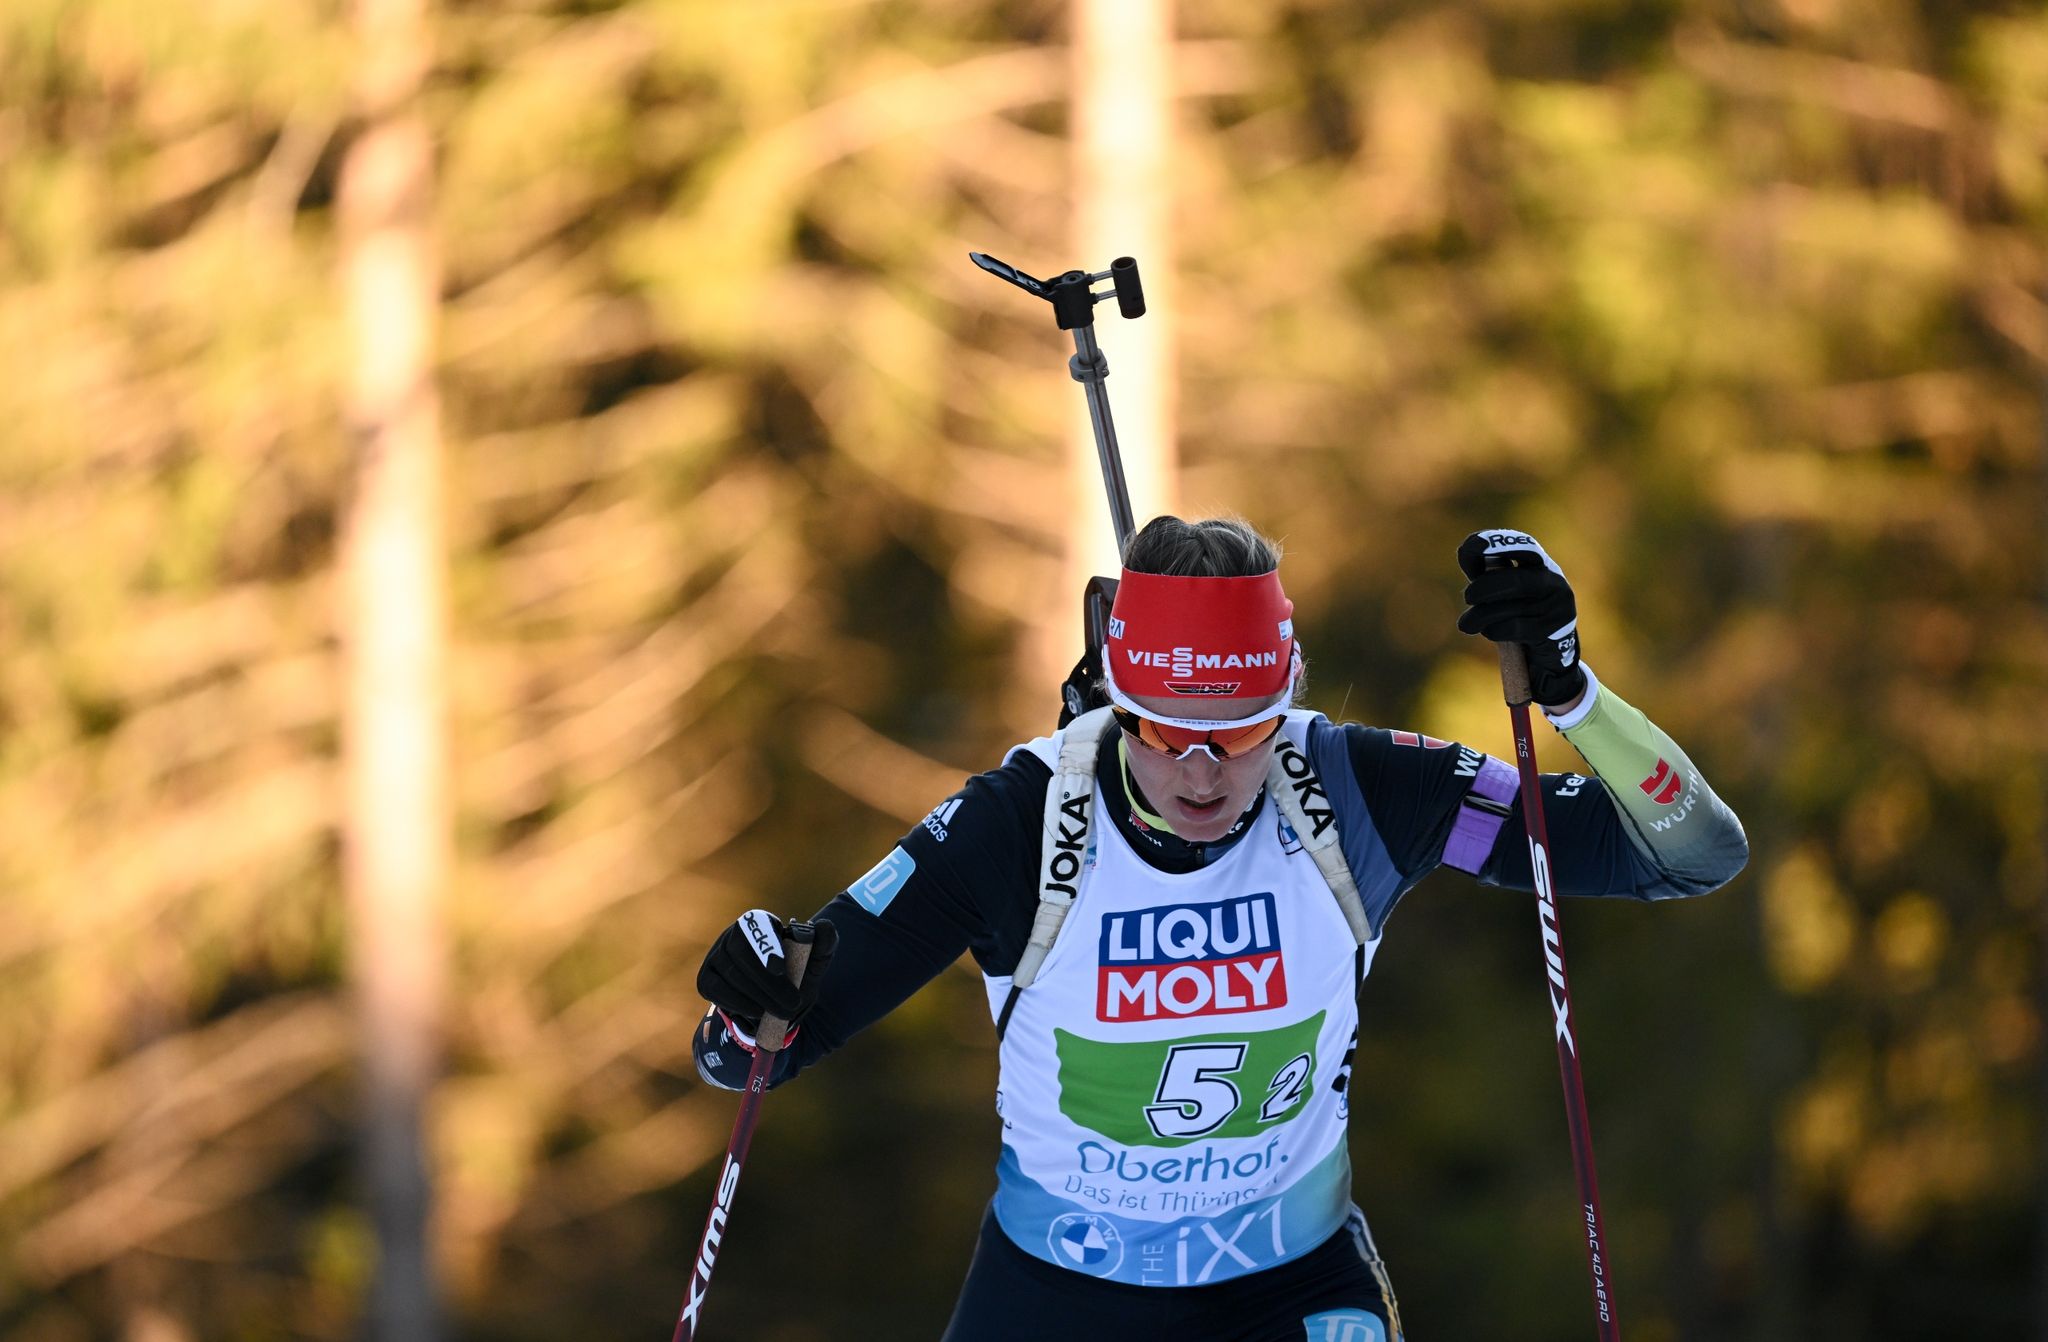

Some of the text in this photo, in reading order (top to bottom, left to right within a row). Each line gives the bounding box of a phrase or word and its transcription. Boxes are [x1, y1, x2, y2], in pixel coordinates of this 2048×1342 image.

[1127, 647, 1277, 678] VIESSMANN
[1517, 736, 1529, 759] TCS
[1648, 768, 1699, 832] WÜRTH
[1108, 898, 1272, 961] LIQUI
[1105, 956, 1280, 1019] MOLY
[751, 1074, 764, 1094] TCS
[1143, 1041, 1250, 1139] 5
[1257, 1051, 1312, 1124] 2
[1064, 1174, 1111, 1205] Das
[1117, 1189, 1148, 1212] ist
[1142, 1243, 1165, 1287] THE
[1584, 1203, 1599, 1250] TRIAC
[1595, 1276, 1610, 1323] AERO
